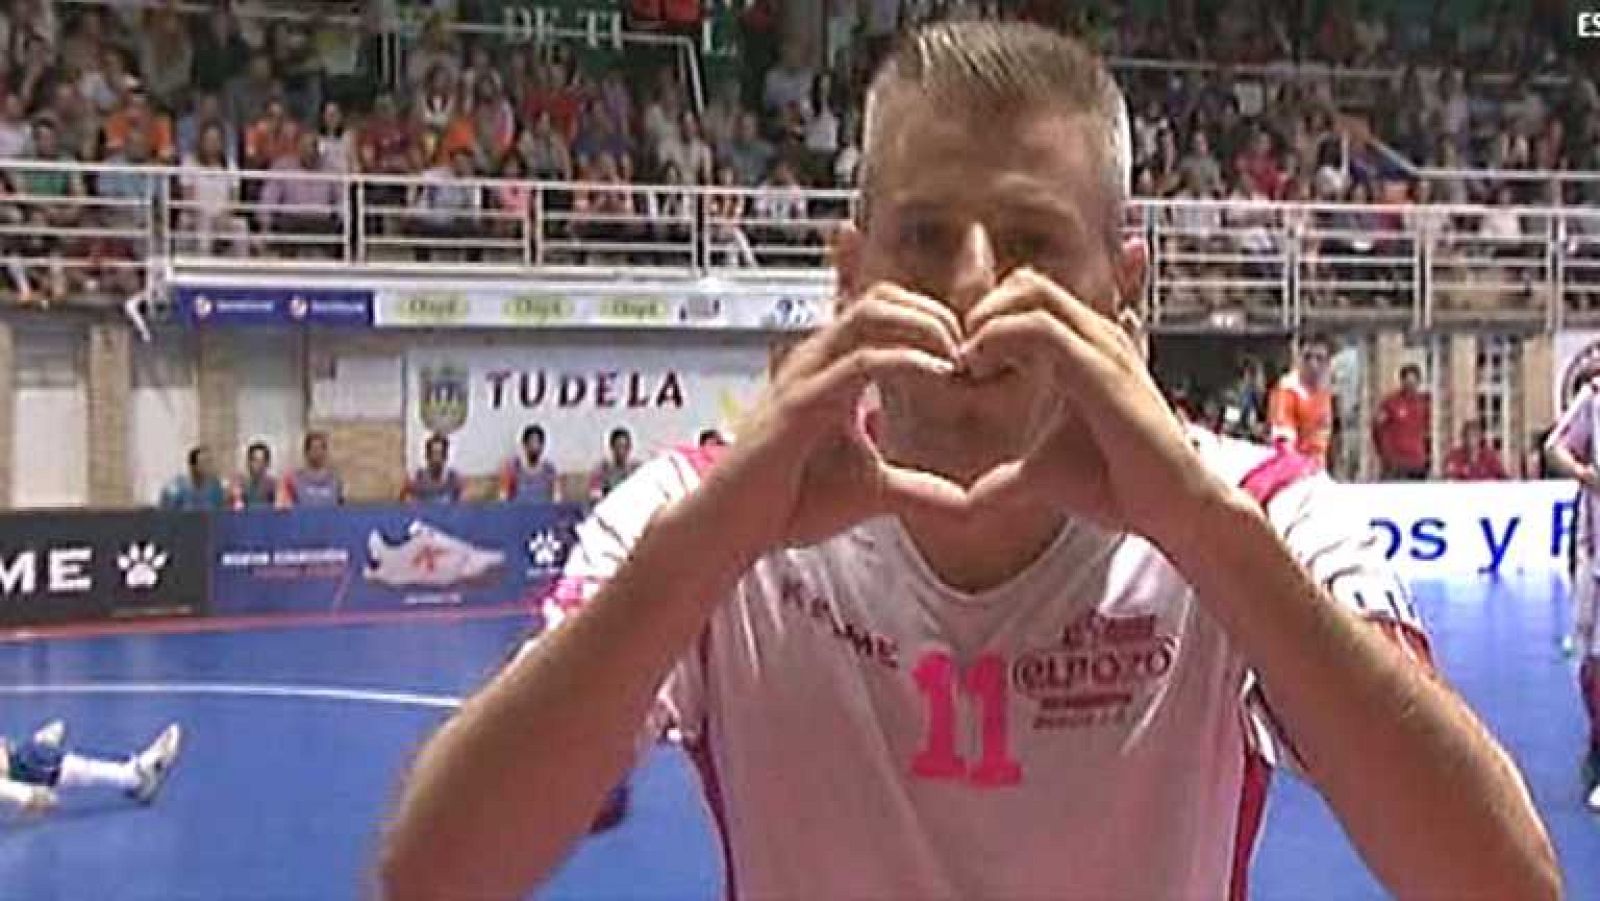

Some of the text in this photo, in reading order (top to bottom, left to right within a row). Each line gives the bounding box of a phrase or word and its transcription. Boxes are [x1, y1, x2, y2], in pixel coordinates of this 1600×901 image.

[486, 369, 685, 410] TUDELA
[1478, 516, 1522, 577] y
[911, 648, 1022, 788] 11
